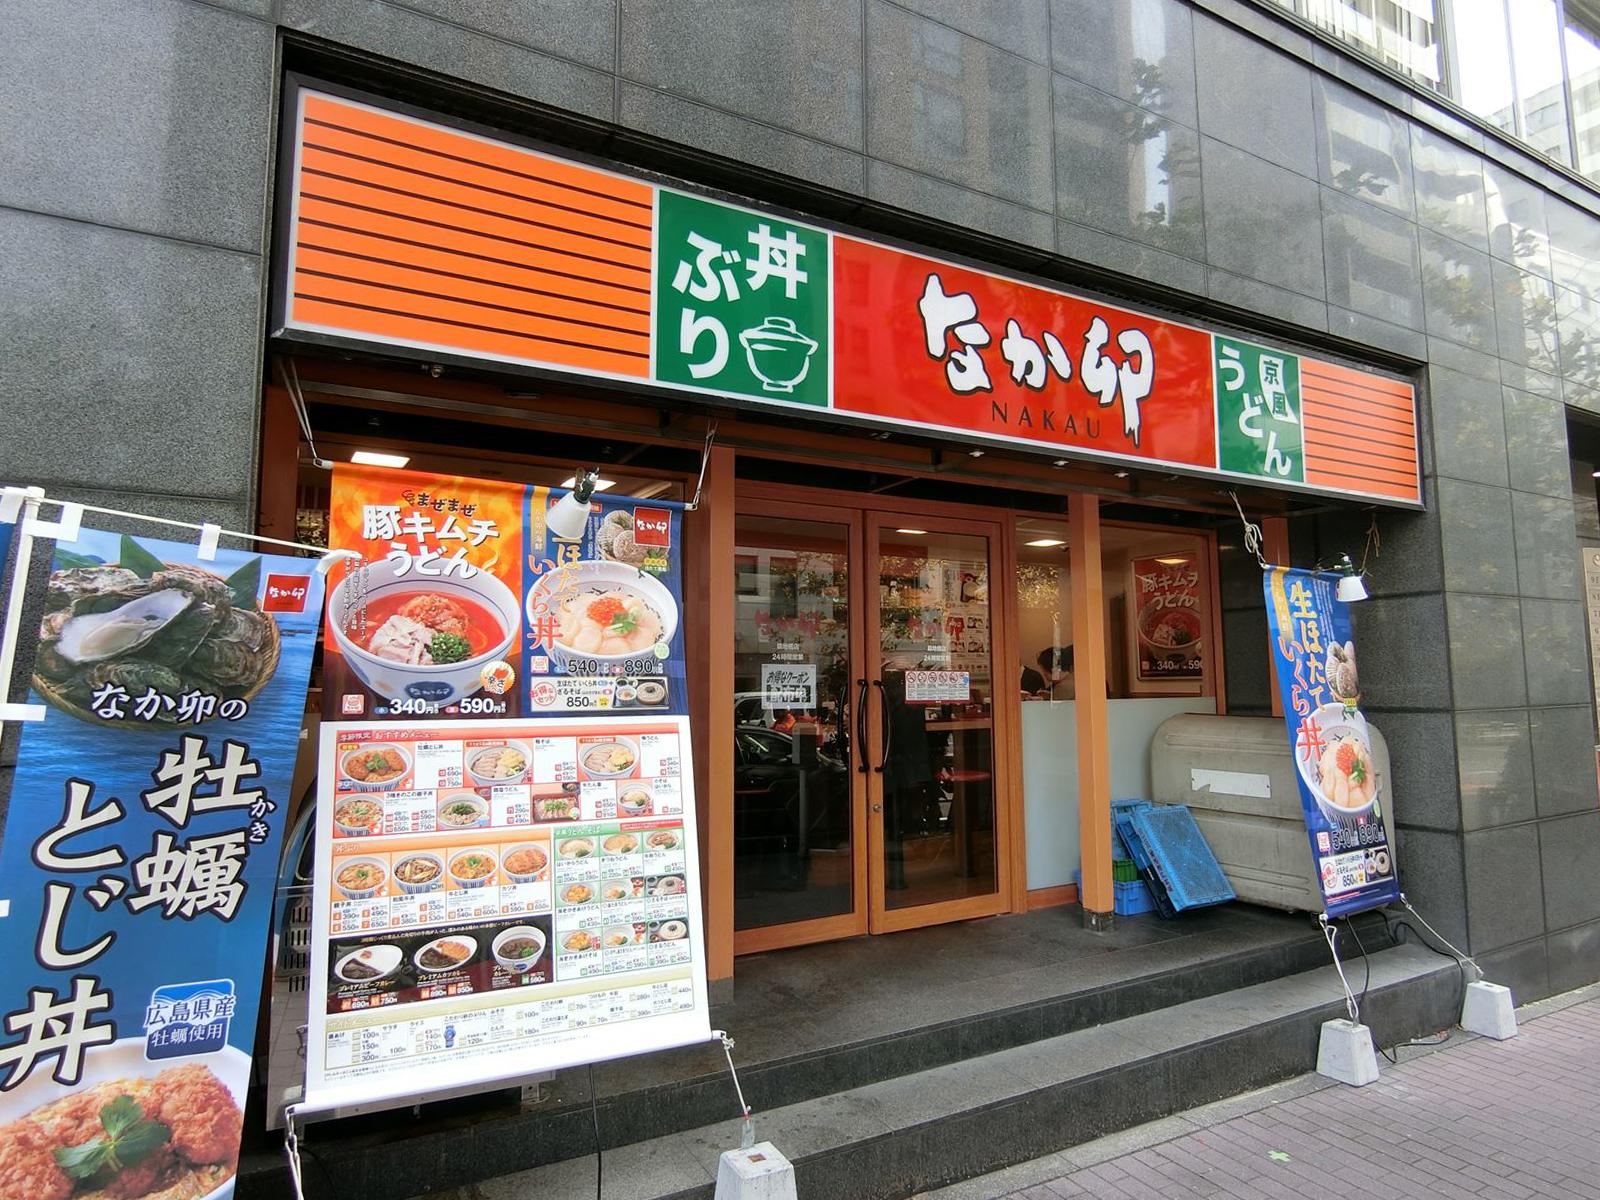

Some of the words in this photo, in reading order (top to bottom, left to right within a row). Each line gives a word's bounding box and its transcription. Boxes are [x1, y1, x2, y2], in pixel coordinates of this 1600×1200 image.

[918, 272, 1154, 448] なか卯
[991, 400, 1101, 439] NAKAU
[1219, 344, 1292, 476] うどん
[362, 503, 501, 547] 豚キムチ
[417, 492, 477, 518] まぜまぜ
[636, 518, 668, 535] なか卯
[391, 541, 480, 581] うどん
[553, 537, 584, 614] ほたて
[269, 586, 306, 601] なか卯
[527, 554, 564, 650] いくら丼
[1151, 590, 1195, 611] うどん
[1289, 580, 1326, 713] 生ほたて
[91, 683, 249, 724] なか卯の
[1277, 635, 1326, 762] いくら丼
[126, 736, 262, 920] 牡蠣
[249, 797, 277, 845] かき
[0, 782, 124, 1089] とじ丼
[143, 995, 237, 1029] 広島県産
[149, 1022, 225, 1049] 牡蠣使用
